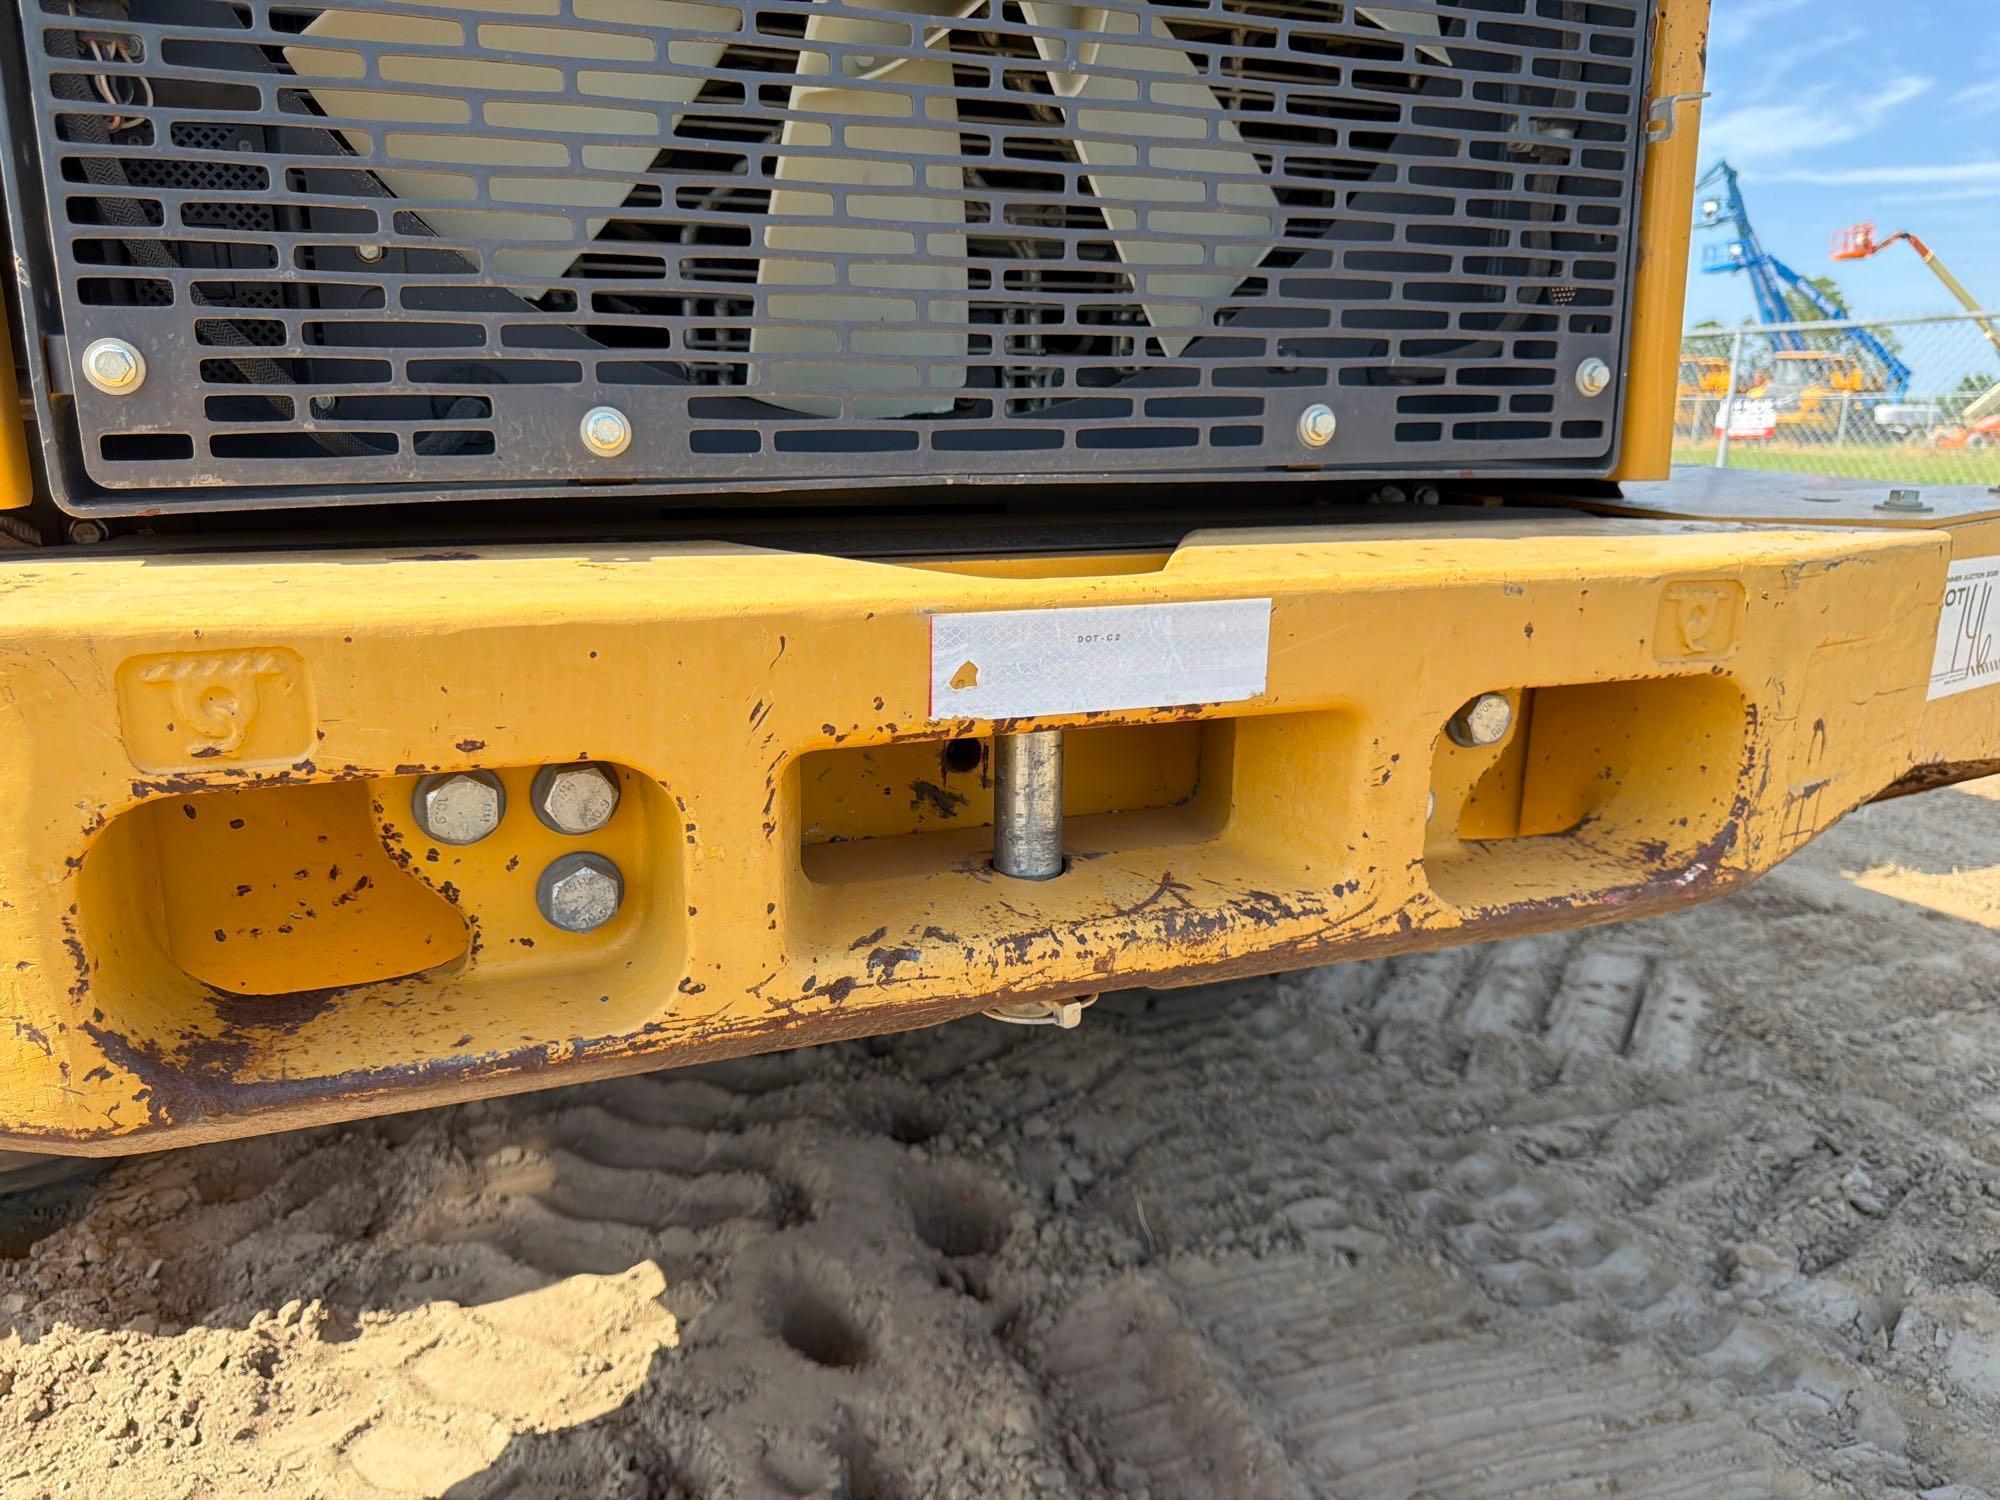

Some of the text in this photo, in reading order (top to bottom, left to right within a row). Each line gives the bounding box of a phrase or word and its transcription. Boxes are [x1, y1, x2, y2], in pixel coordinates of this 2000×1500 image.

[1945, 587, 1966, 607] OT
[1077, 633, 1121, 642] DOT-C2
[1950, 581, 1992, 677] 146
